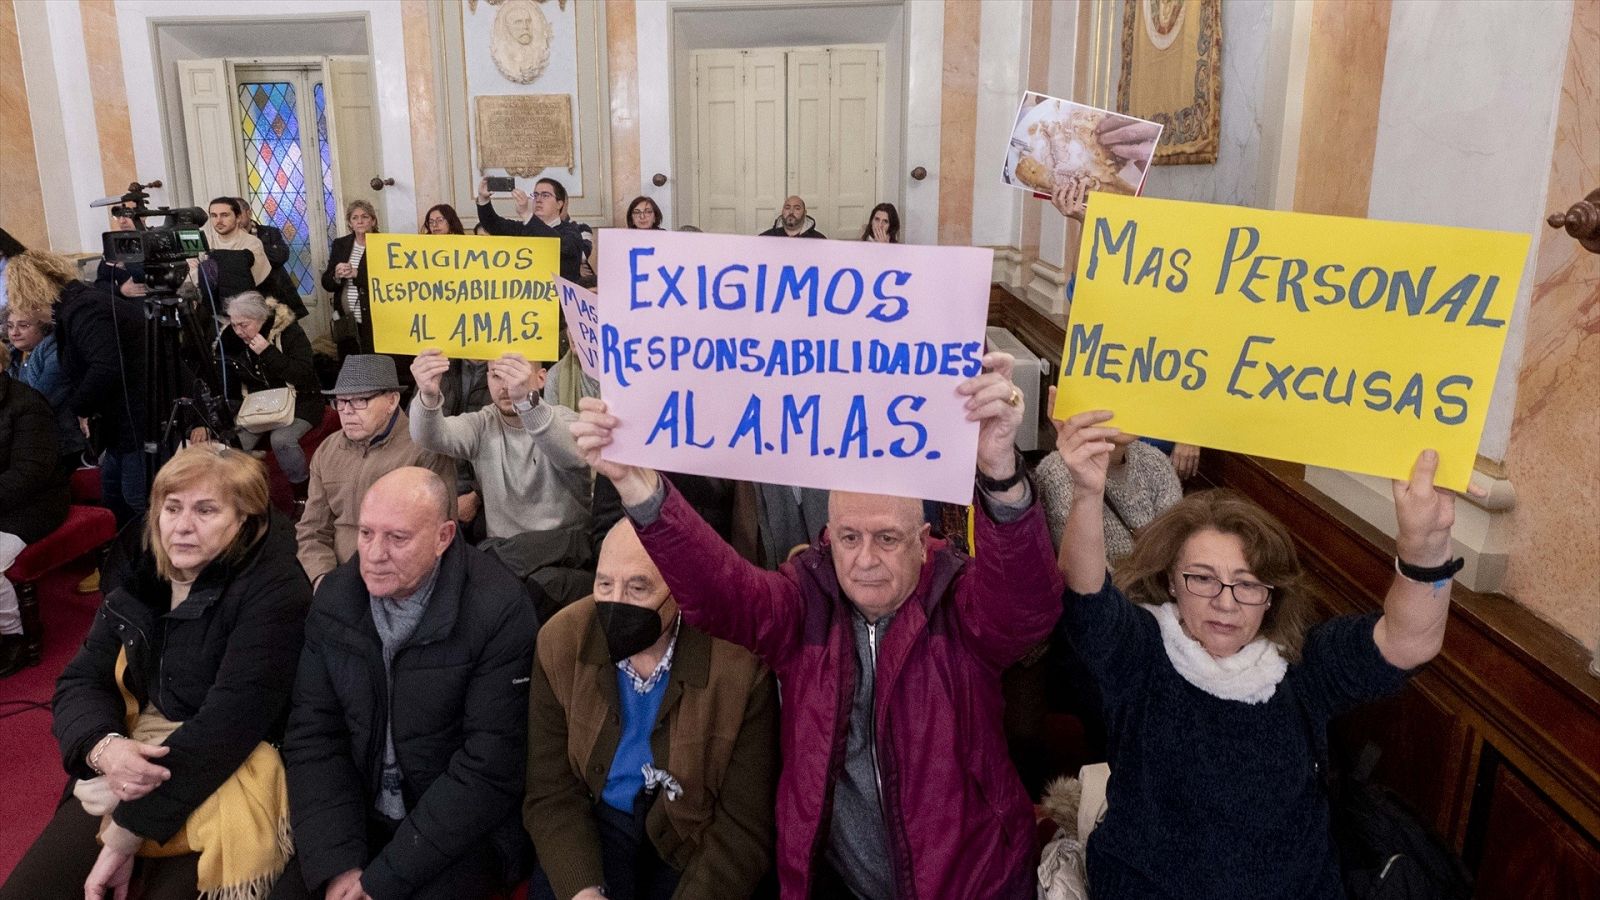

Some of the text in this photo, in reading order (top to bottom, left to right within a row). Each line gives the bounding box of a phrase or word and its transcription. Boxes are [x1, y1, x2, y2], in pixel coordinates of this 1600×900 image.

[387, 242, 533, 269] EXIGIMOS
[629, 247, 912, 323] EXIGIMOS
[1086, 217, 1506, 328] MAS PERSONAL
[409, 311, 543, 347] AL A.M.A.S.
[601, 323, 983, 388] RESPONSABILIDADES
[1064, 323, 1474, 426] MENOS EXCUSAS
[644, 389, 942, 460] AL A.M.A.S.
